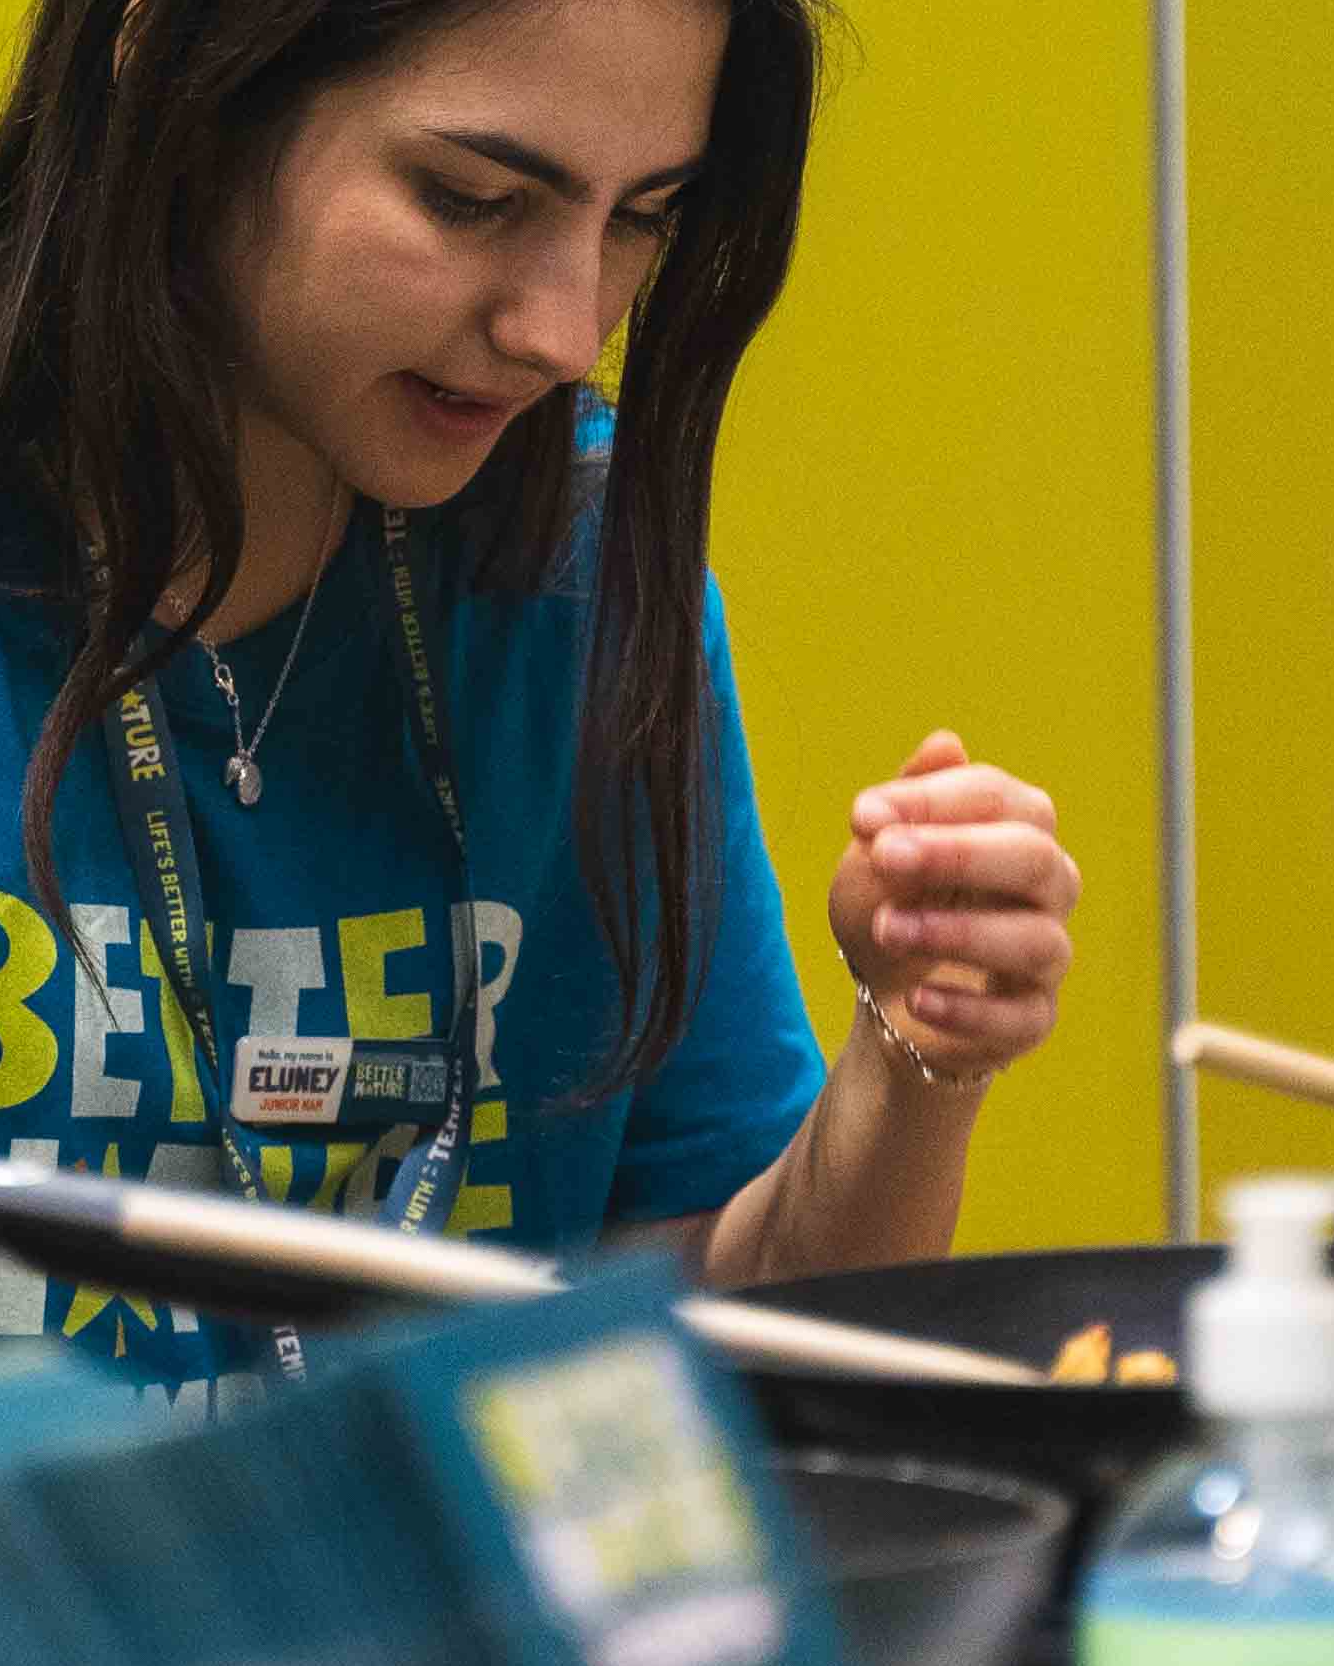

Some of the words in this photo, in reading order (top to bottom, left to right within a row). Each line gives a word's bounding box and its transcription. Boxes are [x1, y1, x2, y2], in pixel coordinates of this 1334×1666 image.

[120, 687, 166, 782] TURE
[146, 810, 175, 871] LIFE'S
[160, 873, 188, 942] BETTER
[249, 1065, 340, 1094] ELUNEY
